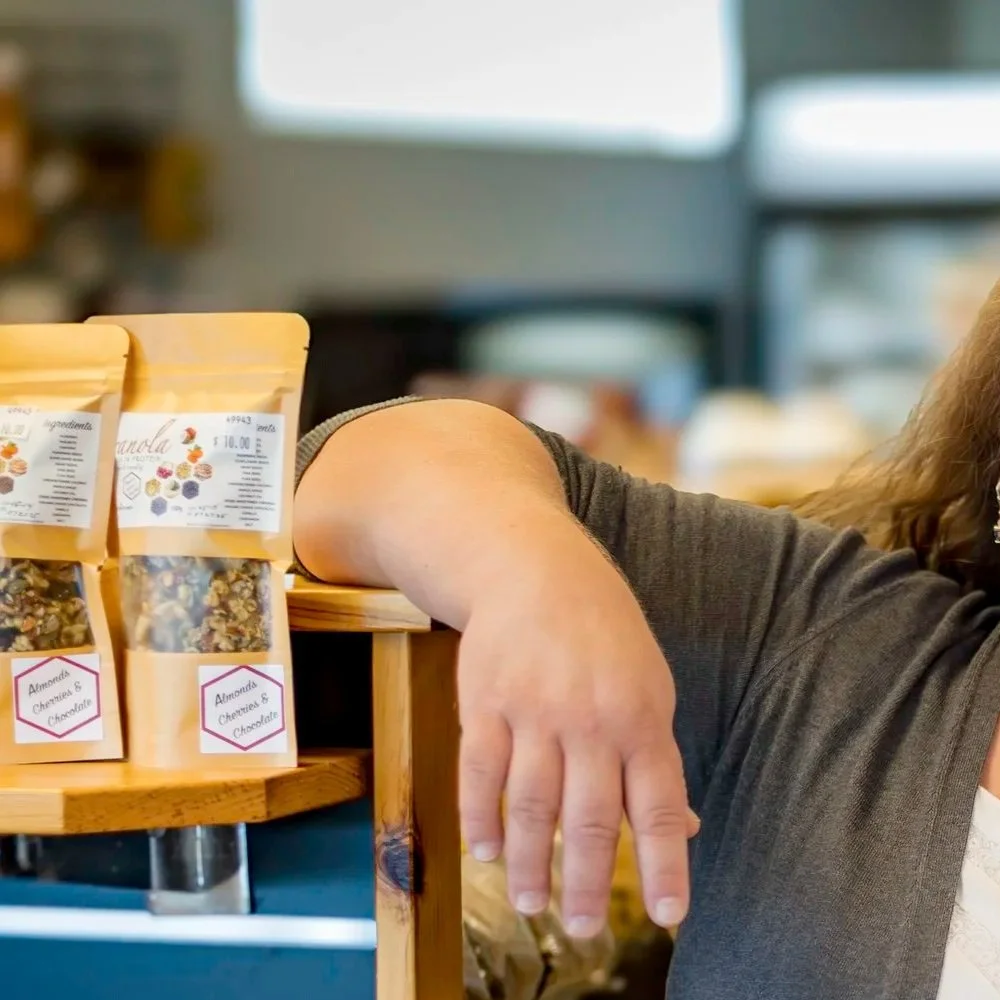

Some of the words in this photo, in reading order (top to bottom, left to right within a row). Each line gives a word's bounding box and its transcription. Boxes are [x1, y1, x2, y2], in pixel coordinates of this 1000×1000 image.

[226, 415, 251, 424] 49943
[224, 435, 251, 450] 10.00
[28, 669, 70, 696] Almonds
[215, 680, 258, 707] Almonds
[32, 688, 73, 715] Cherries
[74, 680, 82, 693] &
[218, 701, 260, 726] Cherries
[261, 692, 269, 704] &
[47, 699, 92, 727] Chocolate
[233, 711, 278, 739] Chocolate
